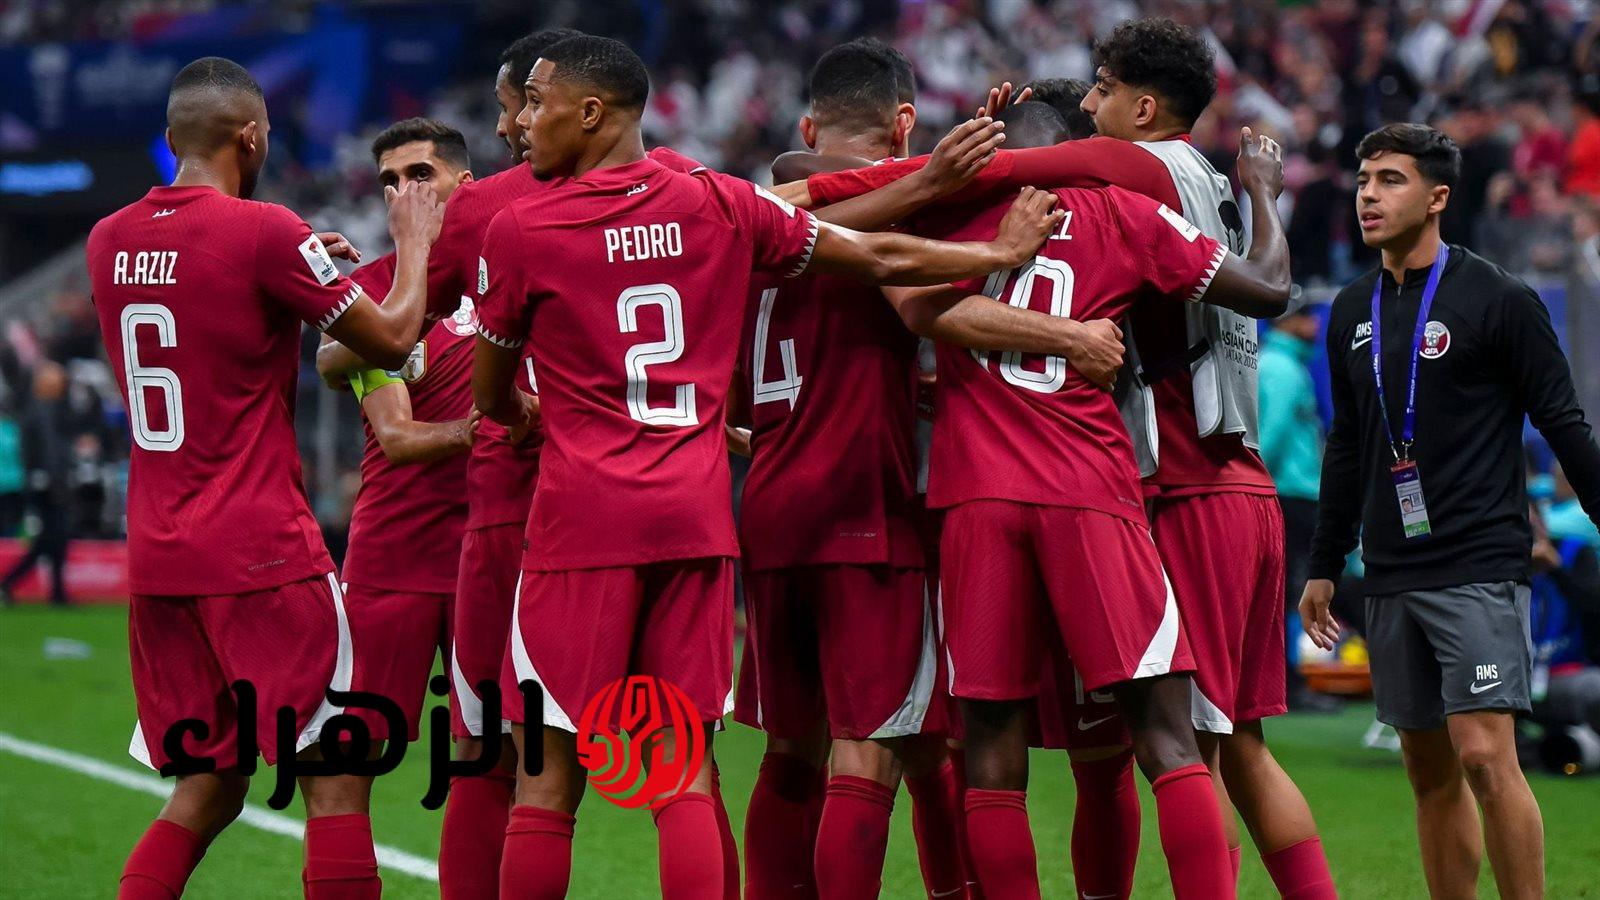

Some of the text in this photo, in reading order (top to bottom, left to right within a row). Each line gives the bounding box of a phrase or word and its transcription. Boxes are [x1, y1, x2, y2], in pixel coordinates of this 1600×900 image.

[604, 222, 683, 263] PEDRO
[113, 251, 178, 285] A.AZIZ
[753, 287, 803, 413] 4
[1355, 321, 1373, 338] AMS
[616, 283, 699, 427] 2
[120, 303, 185, 452] 6
[1476, 664, 1499, 681] AMS
